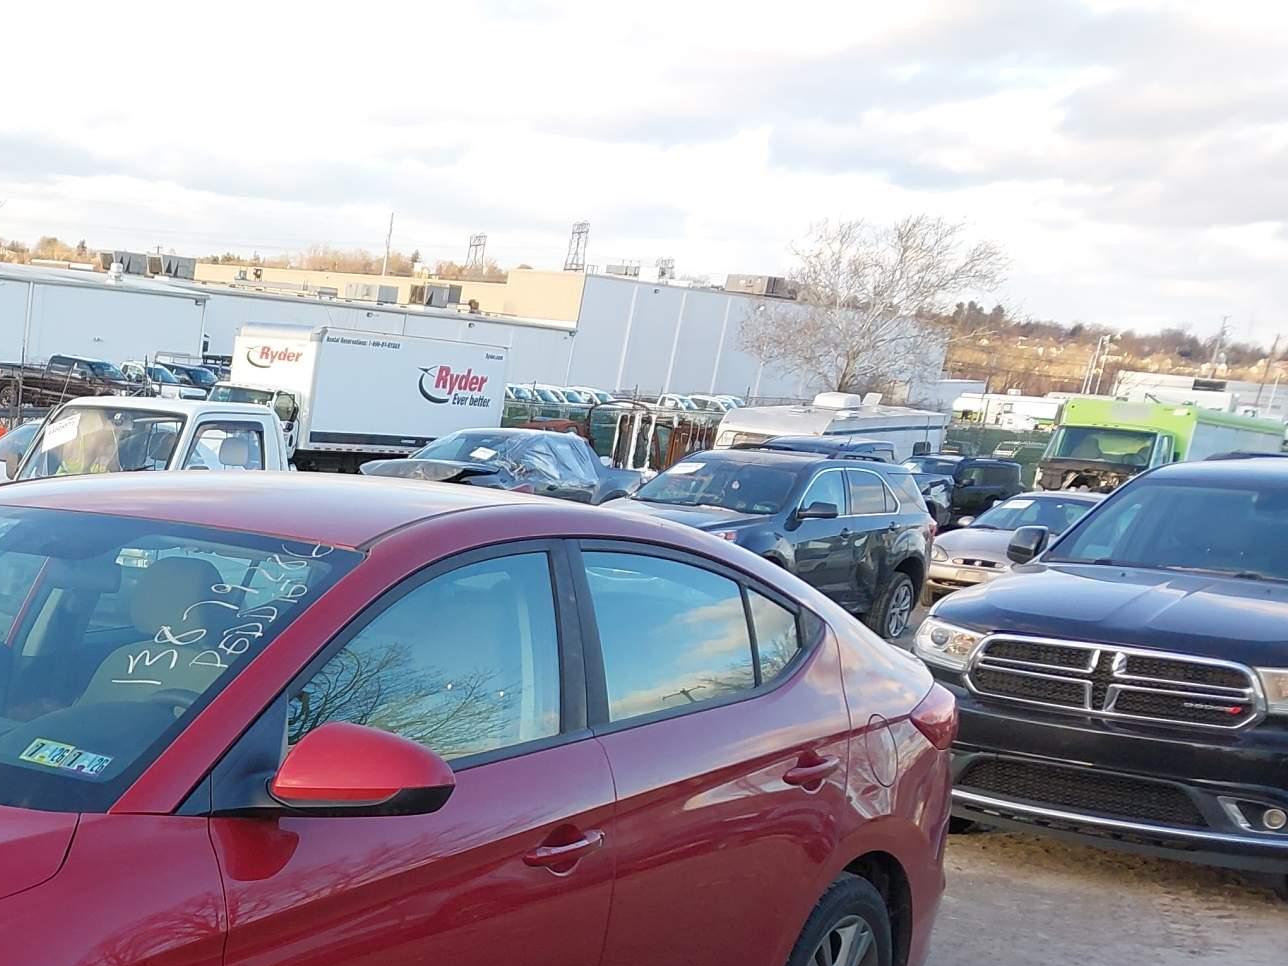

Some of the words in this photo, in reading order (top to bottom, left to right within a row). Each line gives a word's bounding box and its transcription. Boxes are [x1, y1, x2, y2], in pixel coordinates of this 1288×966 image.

[260, 346, 303, 363] Ryder
[435, 365, 488, 395] Ryder
[452, 393, 469, 406] Ever
